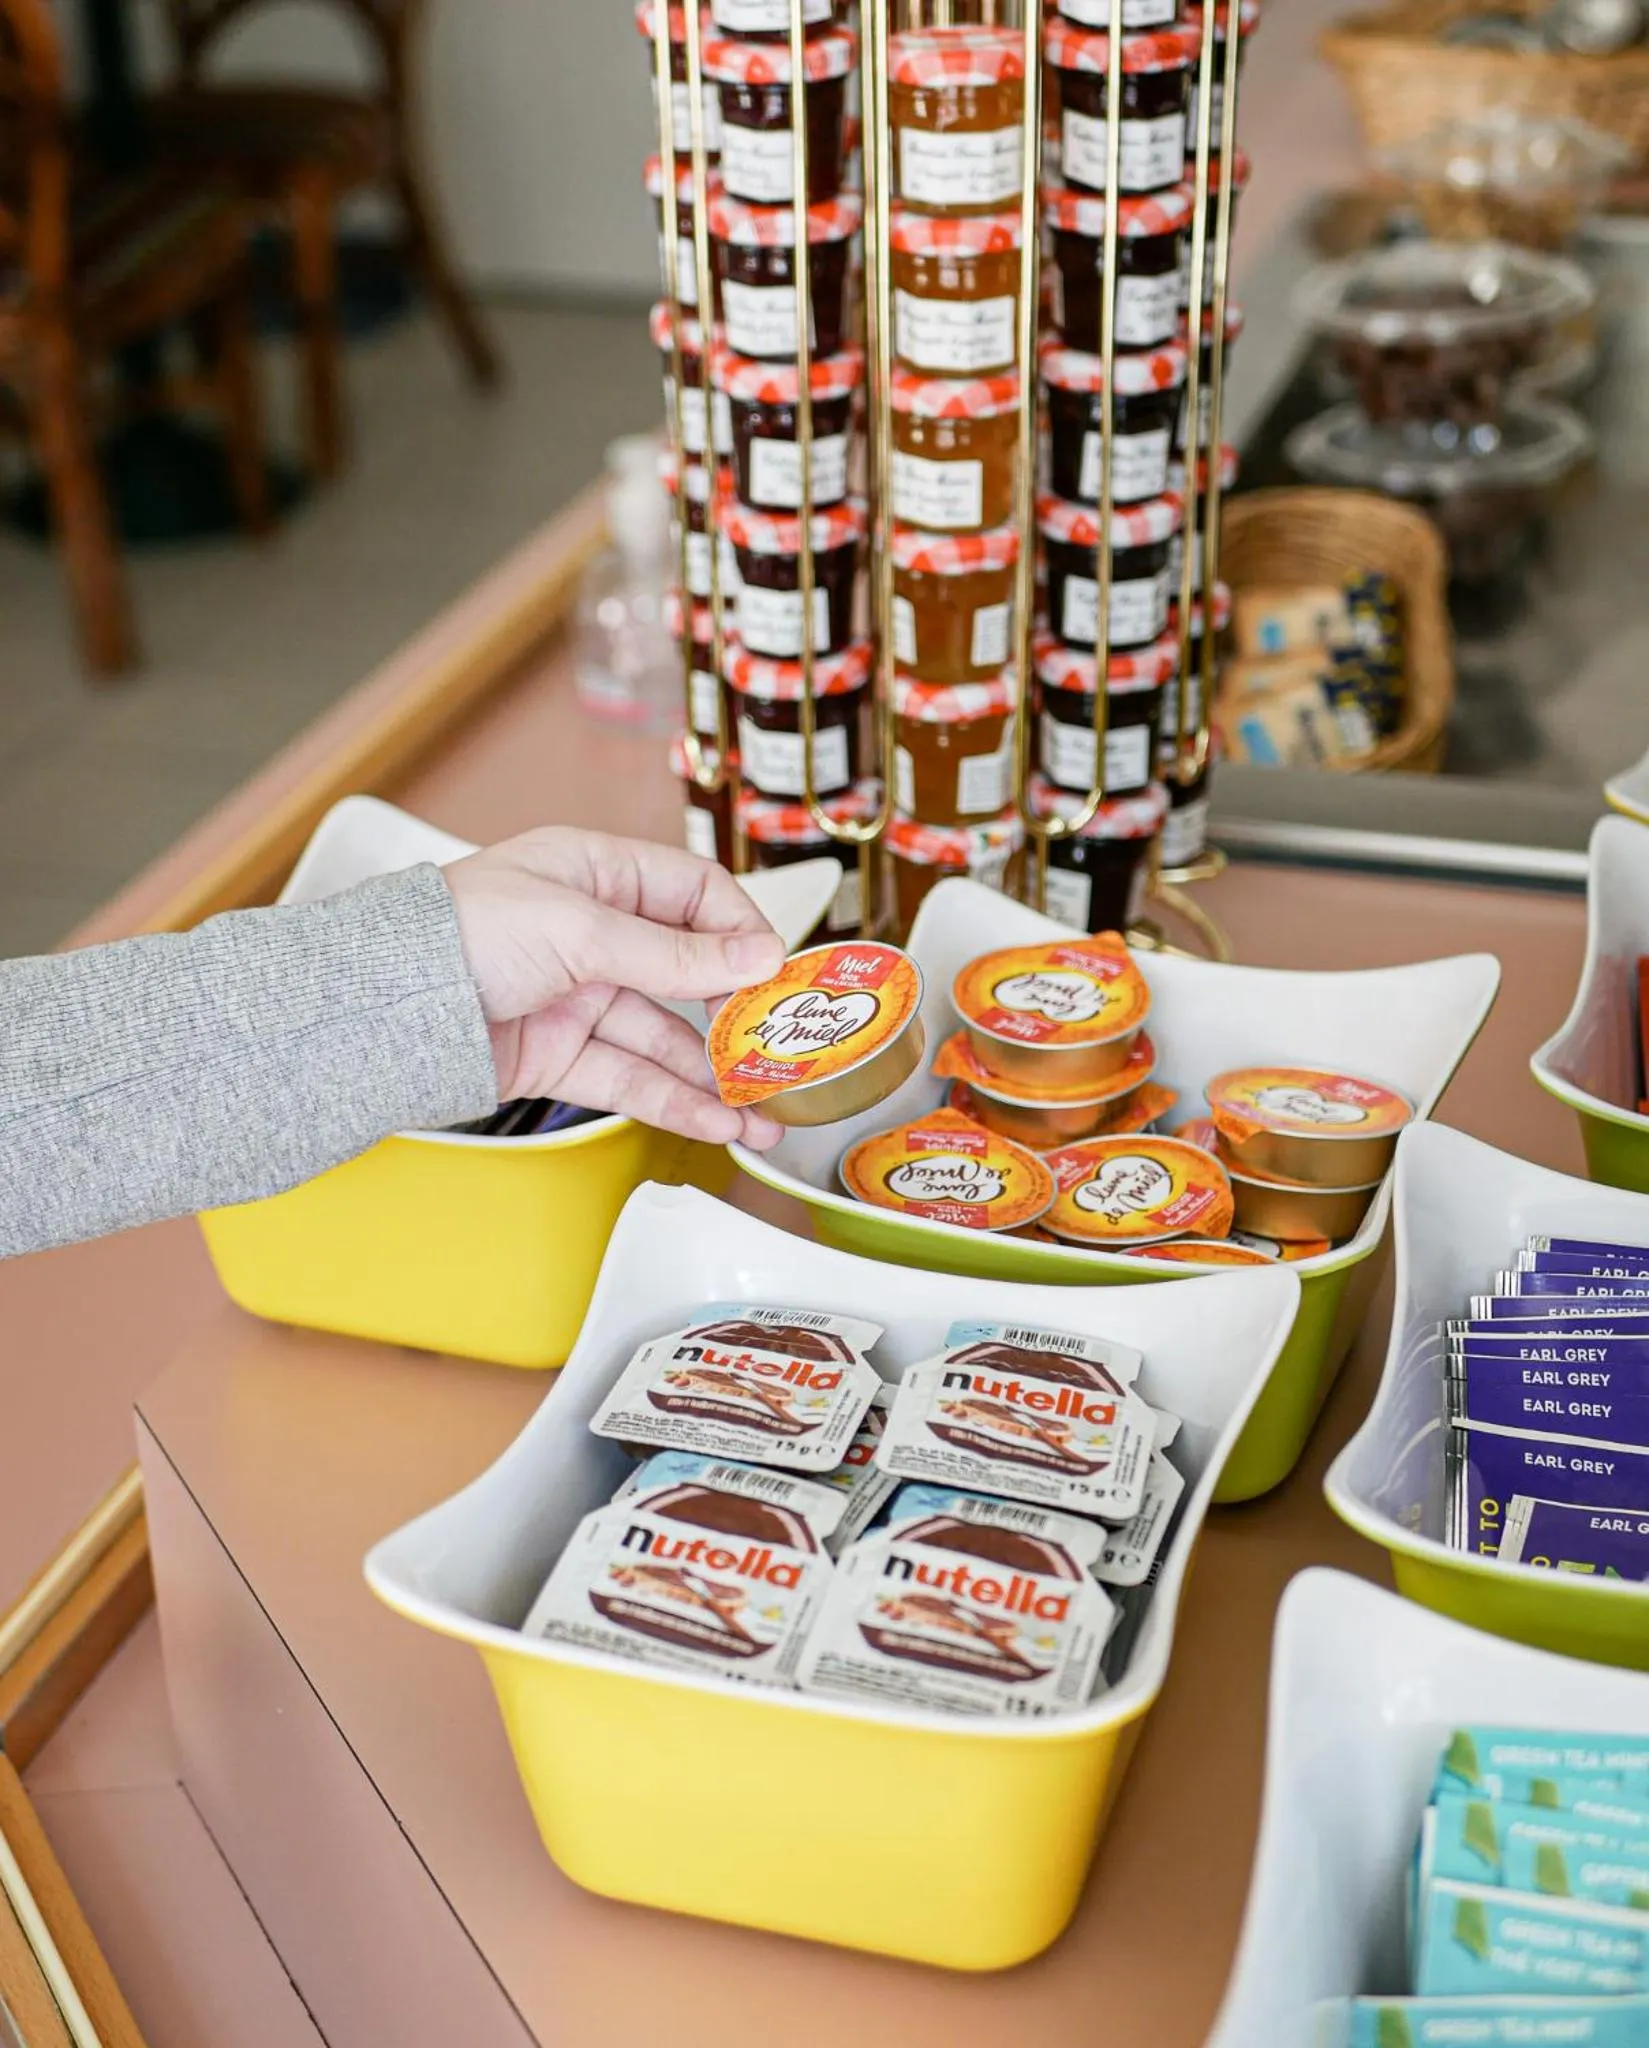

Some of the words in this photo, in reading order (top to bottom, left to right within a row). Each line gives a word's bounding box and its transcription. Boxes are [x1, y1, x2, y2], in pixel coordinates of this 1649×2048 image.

[834, 954, 884, 974] Miel
[743, 1020, 775, 1037] de
[1520, 1348, 1561, 1361] EARL
[1565, 1348, 1607, 1362] GREY
[672, 1345, 844, 1391] nutella
[1522, 1370, 1564, 1385] EARL
[1567, 1372, 1611, 1387] GREY
[942, 1371, 1118, 1426] nutella
[1523, 1398, 1565, 1414] EARL
[1568, 1402, 1612, 1418] GREY
[1524, 1452, 1566, 1469] EARL
[1570, 1458, 1614, 1475] GREY
[1479, 1498, 1500, 1531] TO
[1590, 1517, 1633, 1532] EARL
[620, 1524, 805, 1590] nutella
[883, 1554, 1071, 1623] nutella
